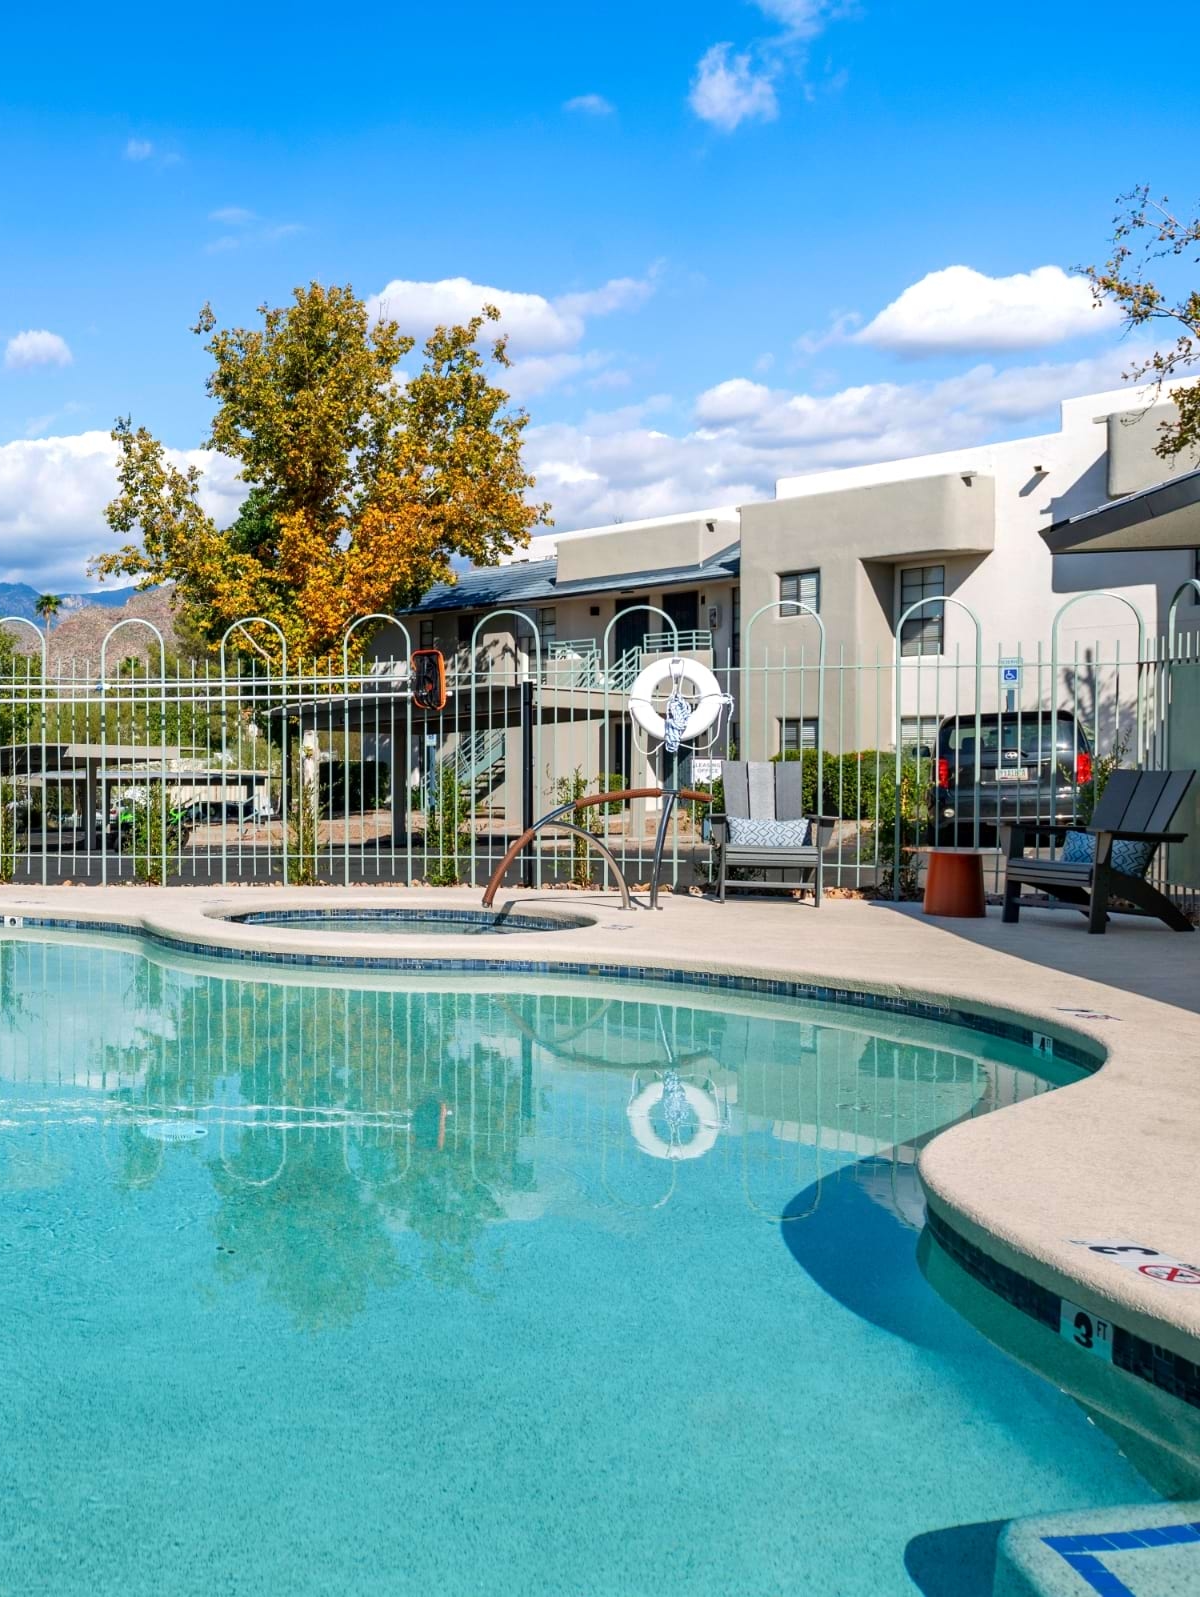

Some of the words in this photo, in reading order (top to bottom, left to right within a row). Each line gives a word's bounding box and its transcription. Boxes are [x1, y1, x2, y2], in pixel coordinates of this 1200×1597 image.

[1088, 1245, 1159, 1256] 3
[1072, 1311, 1094, 1350] 3
[1096, 1320, 1108, 1341] FT
